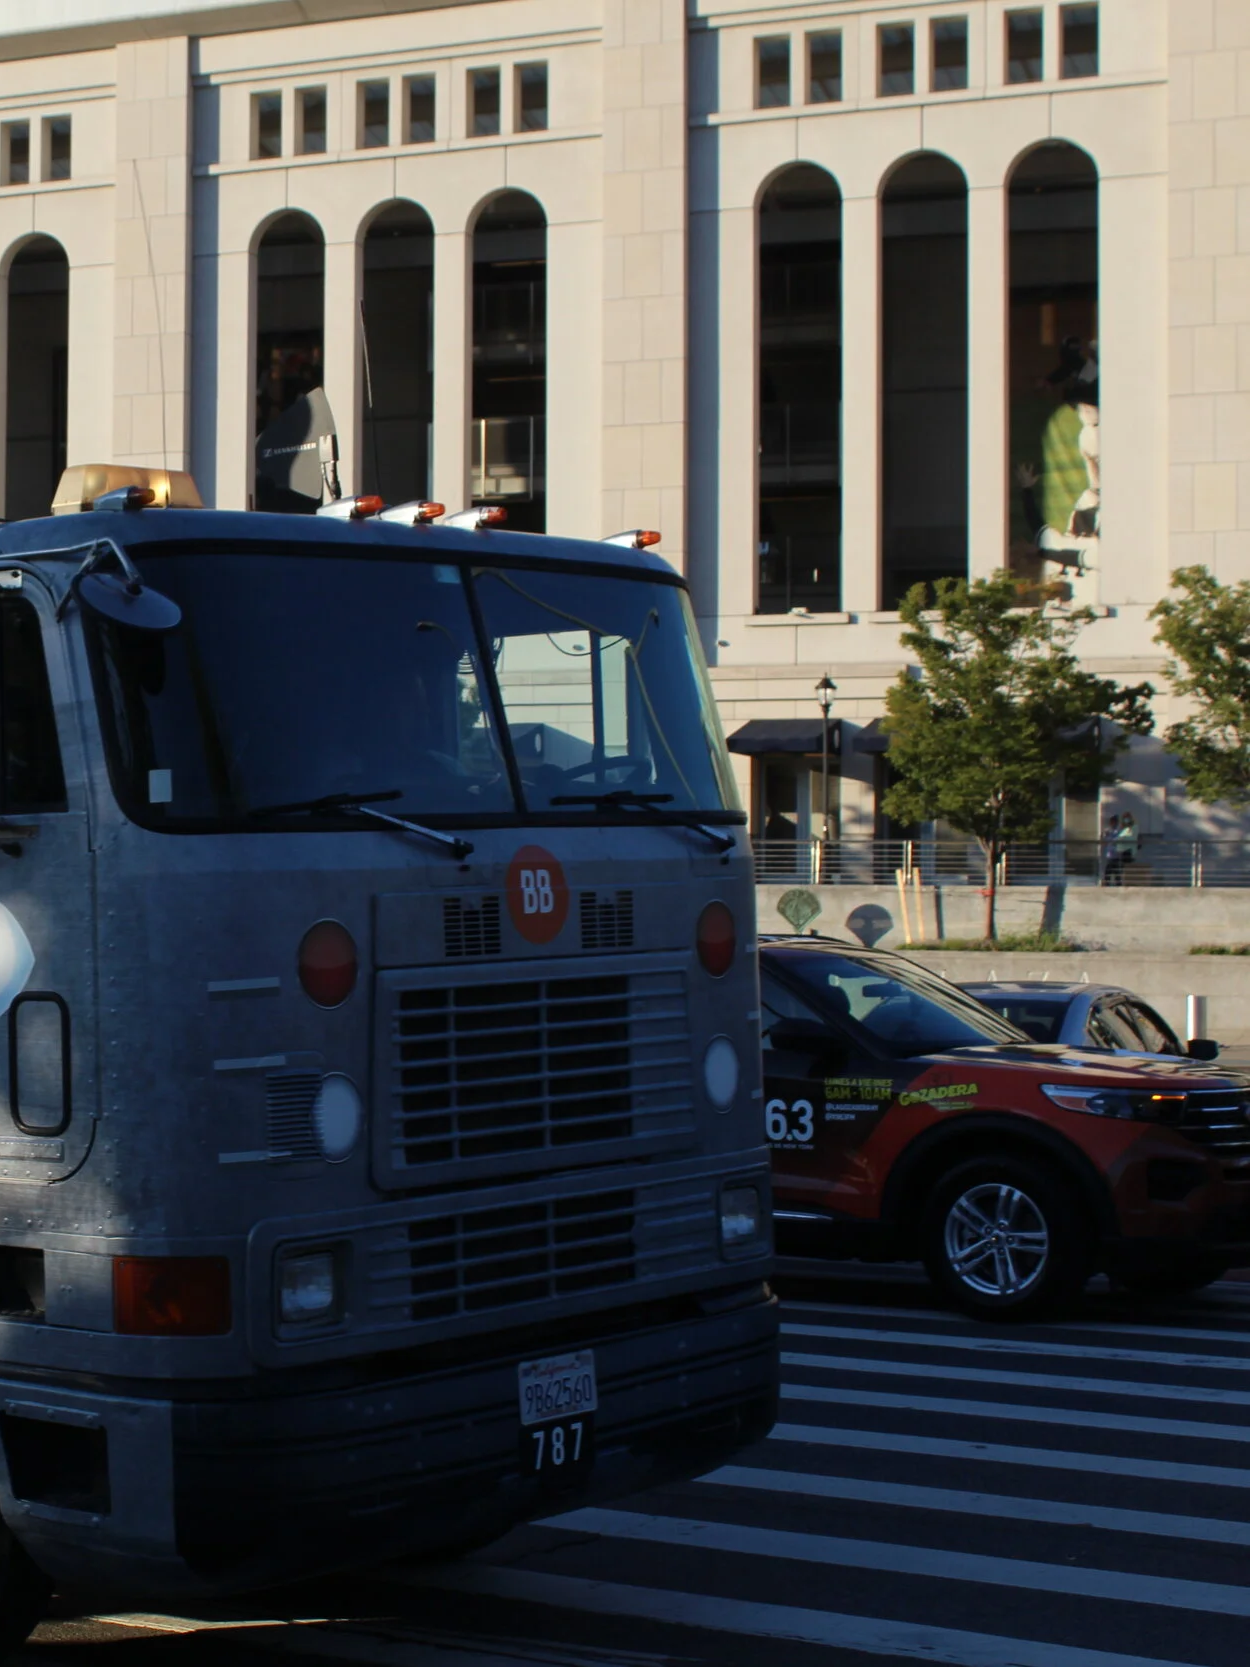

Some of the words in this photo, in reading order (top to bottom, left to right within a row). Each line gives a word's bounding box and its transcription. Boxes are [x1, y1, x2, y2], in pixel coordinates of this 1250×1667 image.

[520, 869, 554, 914] BB
[525, 1373, 592, 1415] 9B62560
[532, 1422, 583, 1470] 787
